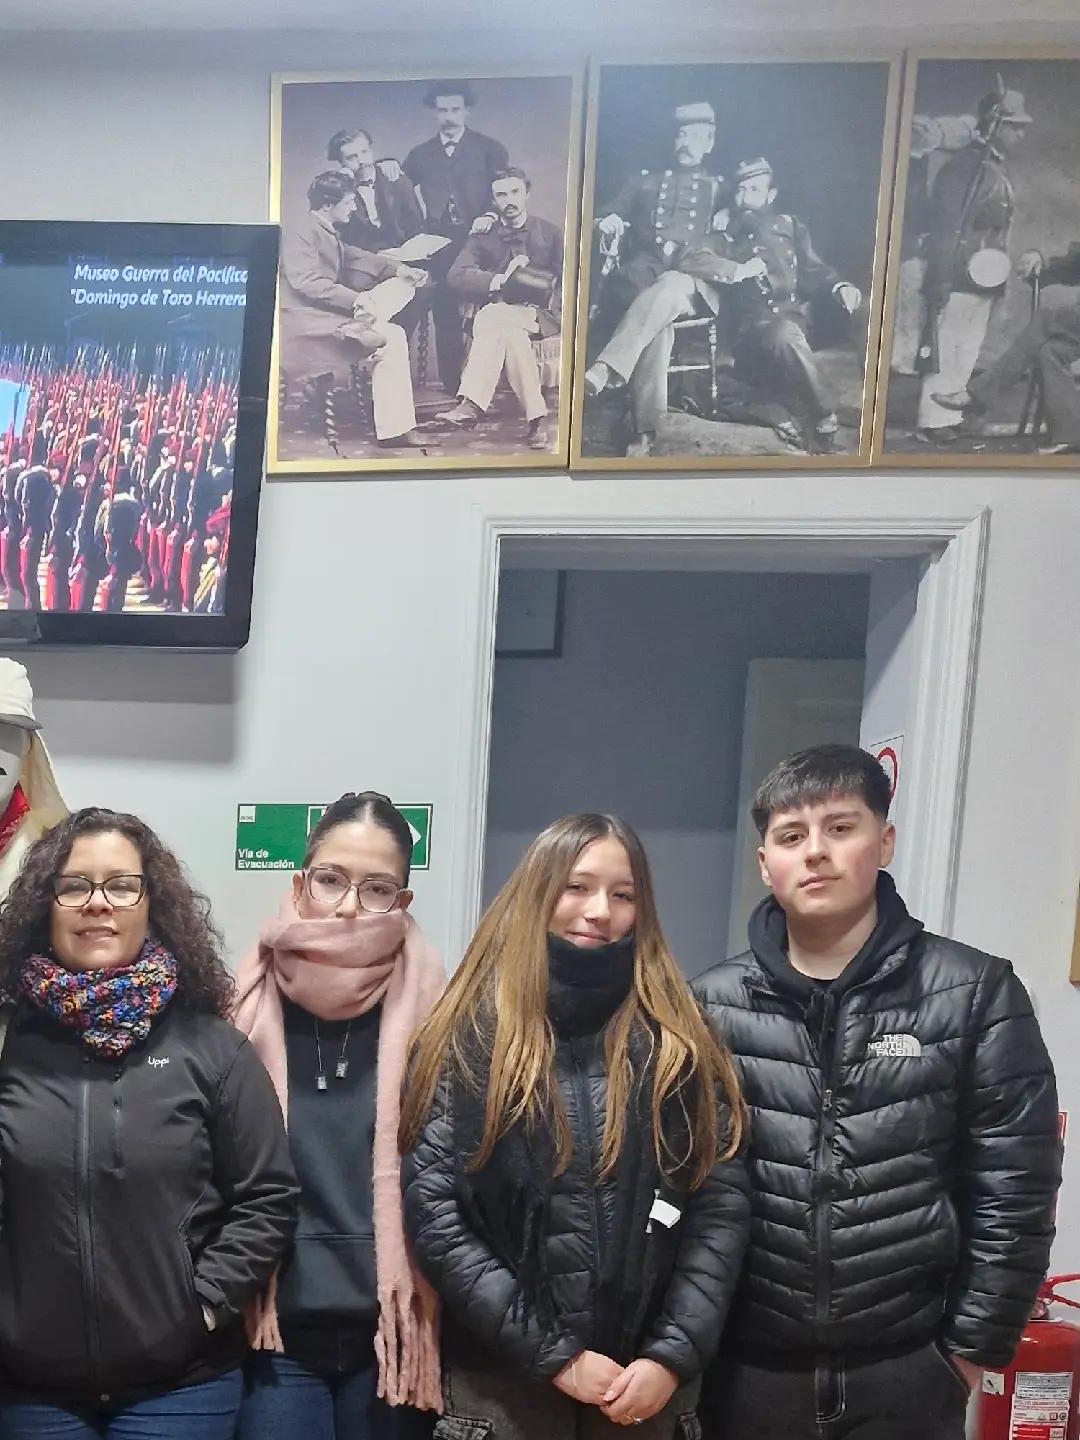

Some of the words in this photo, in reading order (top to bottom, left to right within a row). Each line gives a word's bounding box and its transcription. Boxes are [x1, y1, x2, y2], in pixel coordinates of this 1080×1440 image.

[74, 264, 120, 281] Museo
[122, 265, 169, 282] Guerra
[172, 265, 195, 283] del
[140, 288, 158, 306] de
[162, 289, 193, 306] Toro
[195, 290, 247, 306] Herrera
[256, 848, 269, 859] de
[238, 859, 295, 869] Evacuación
[882, 1034, 904, 1042] THE
[876, 1048, 904, 1057] FACE
